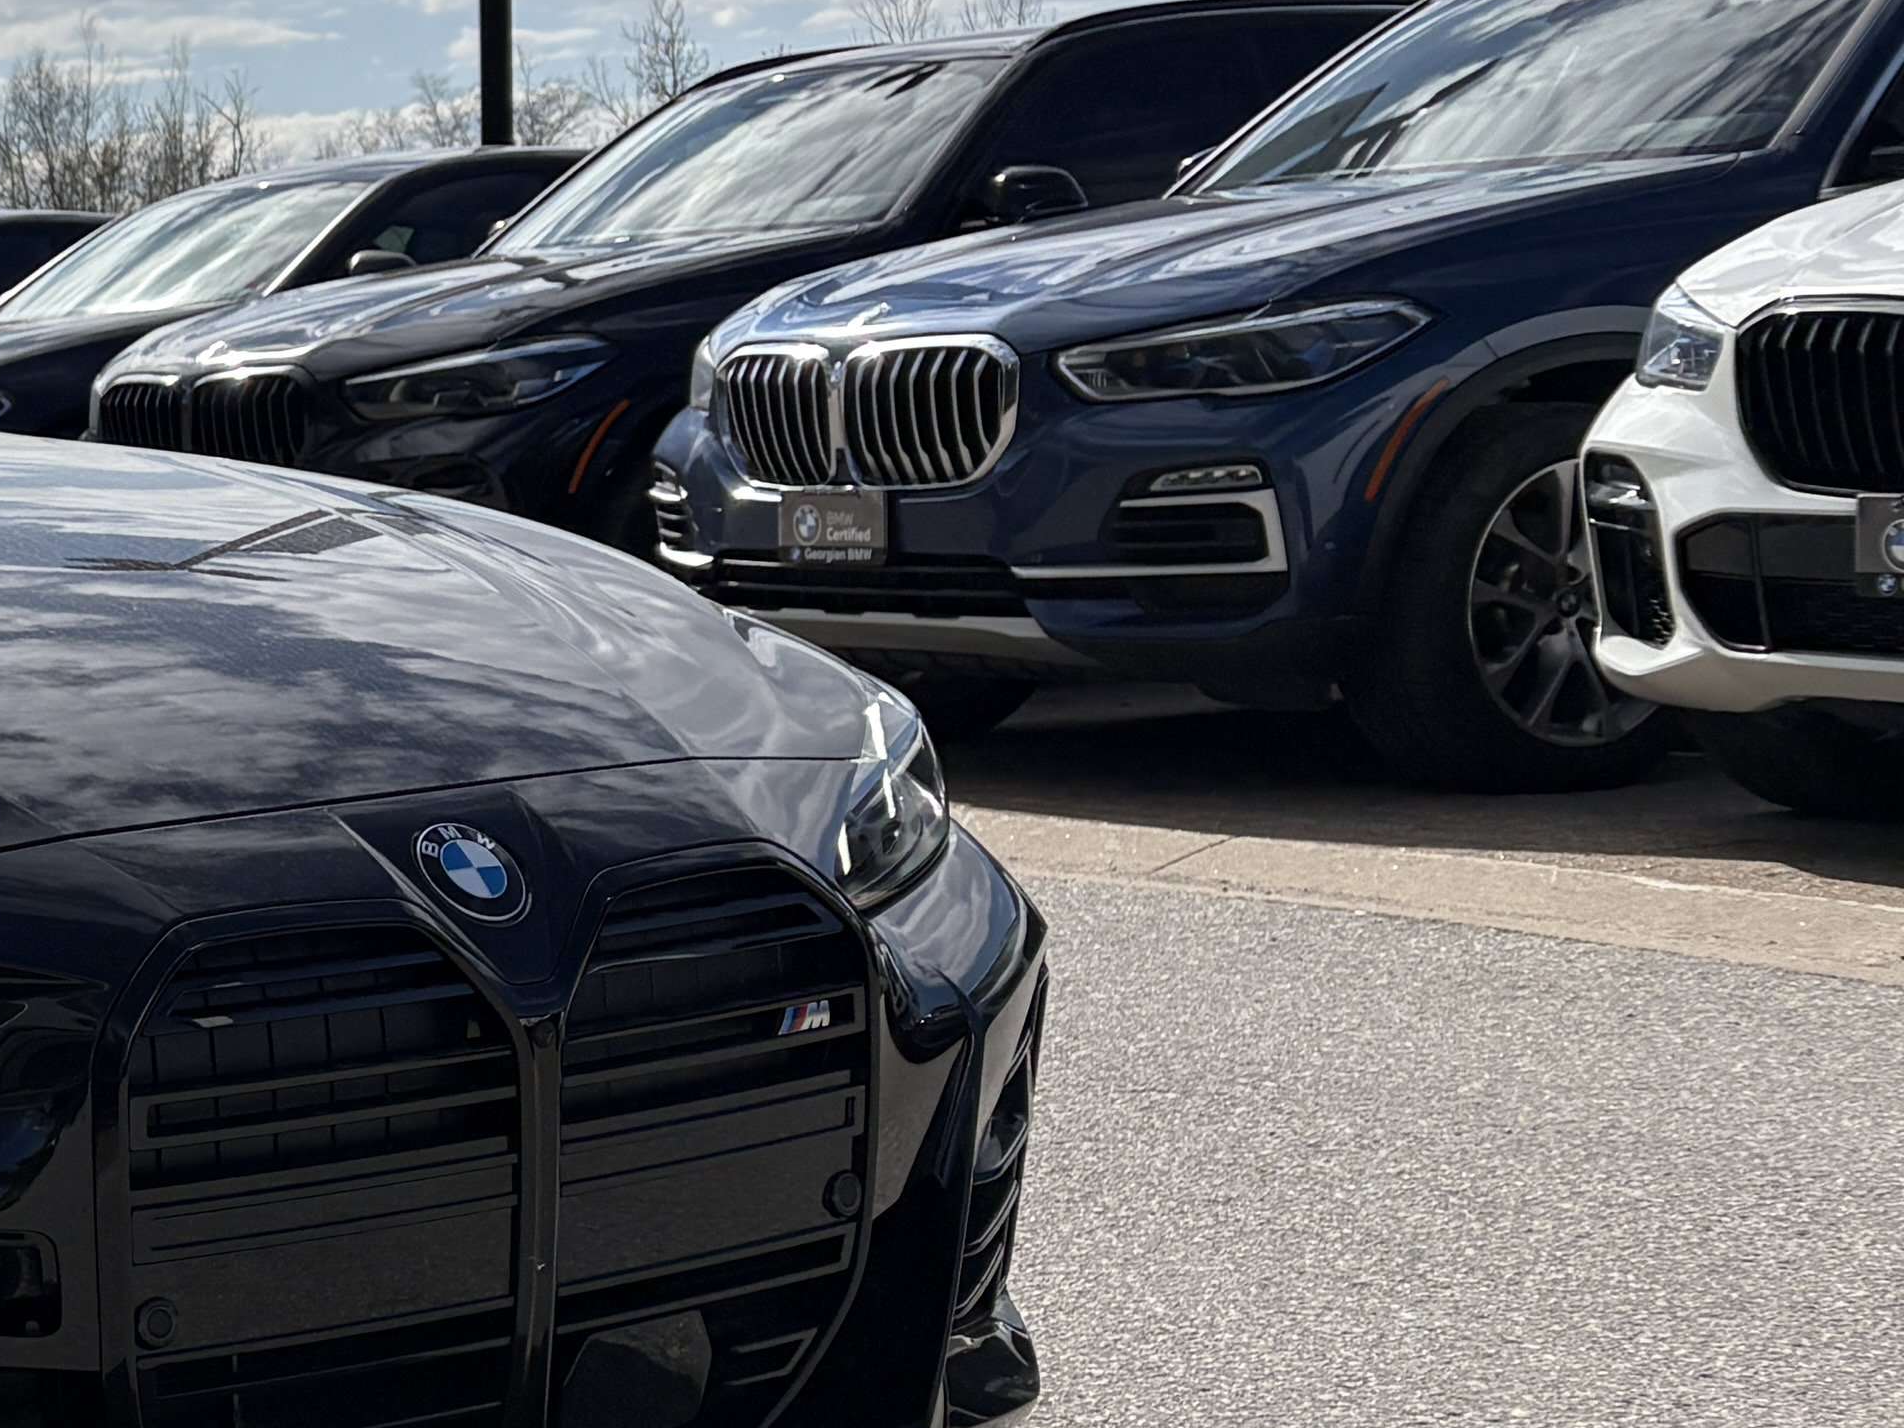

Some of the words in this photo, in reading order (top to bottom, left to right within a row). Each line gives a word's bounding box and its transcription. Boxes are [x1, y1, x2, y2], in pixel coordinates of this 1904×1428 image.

[826, 511, 854, 525] BMW
[826, 526, 872, 542] Certified
[804, 548, 846, 563] Georgian
[847, 548, 872, 561] BMW
[422, 826, 497, 858] BMW
